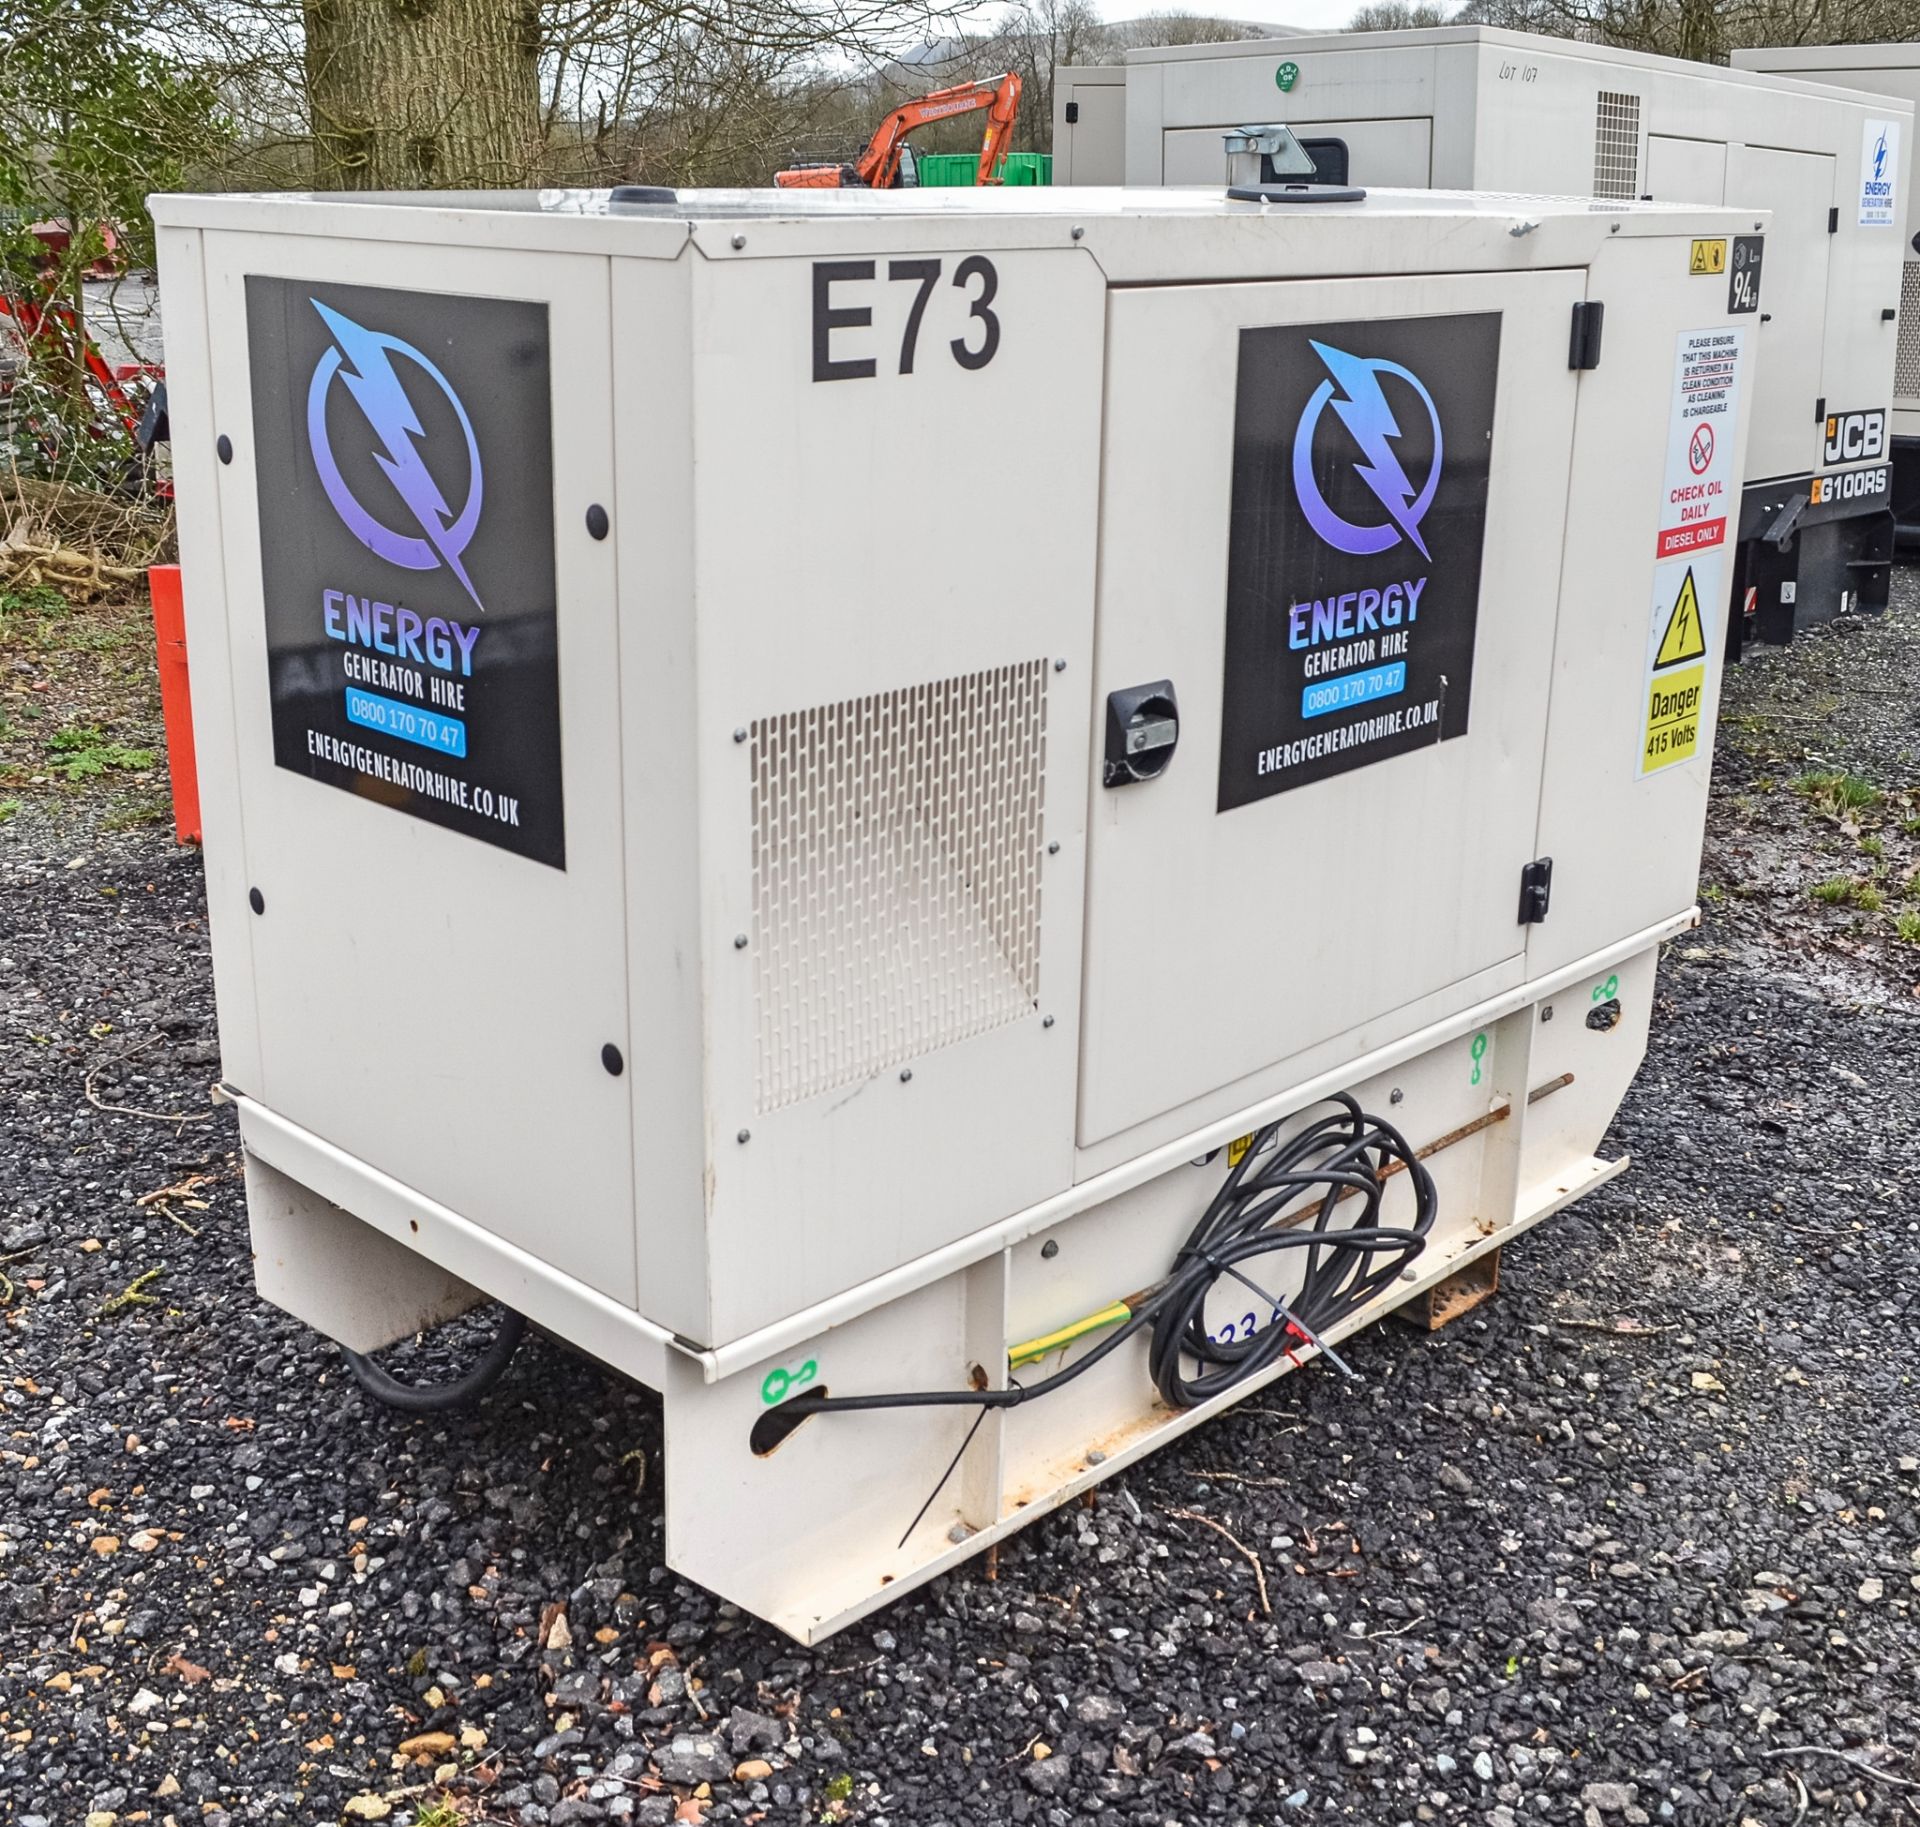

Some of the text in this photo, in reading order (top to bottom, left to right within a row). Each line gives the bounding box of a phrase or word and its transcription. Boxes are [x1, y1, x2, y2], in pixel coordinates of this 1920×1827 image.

[1499, 61, 1538, 82] LOT 107
[1864, 182, 1891, 196] ENERGY
[812, 254, 1000, 383] E73
[1682, 348, 1738, 363] THAT THIS MACHINE
[1688, 335, 1735, 348] PLEASE ENSURE
[1681, 375, 1733, 391] CLEAN CONDITION
[1684, 362, 1734, 376] IS RETURNED IN A
[1682, 402, 1728, 418] IS CHARGEABLE
[1688, 390, 1725, 403] AS CLEANING
[1825, 413, 1884, 462] JCB
[1670, 480, 1723, 503] CHECK OIL
[1821, 469, 1887, 502] G100RS
[1681, 502, 1710, 522] DAILY
[1664, 525, 1720, 551] DIESEL ONLY
[1289, 577, 1427, 650] ENERGY
[323, 588, 480, 677] ENERGY
[1304, 630, 1409, 678] GENERATOR HIRE
[343, 651, 466, 712] GENERATOR HIRE
[1308, 669, 1401, 711] 0800 170 70 47
[1651, 685, 1700, 720] Danger
[351, 696, 459, 749] 0800 170 70 47
[1257, 699, 1440, 775] ENERGYGENERATORHIRE.CO.UK
[1647, 723, 1696, 757] 415 Volts
[307, 729, 520, 827] ENERGYGENERATORHIRE.CO.UK
